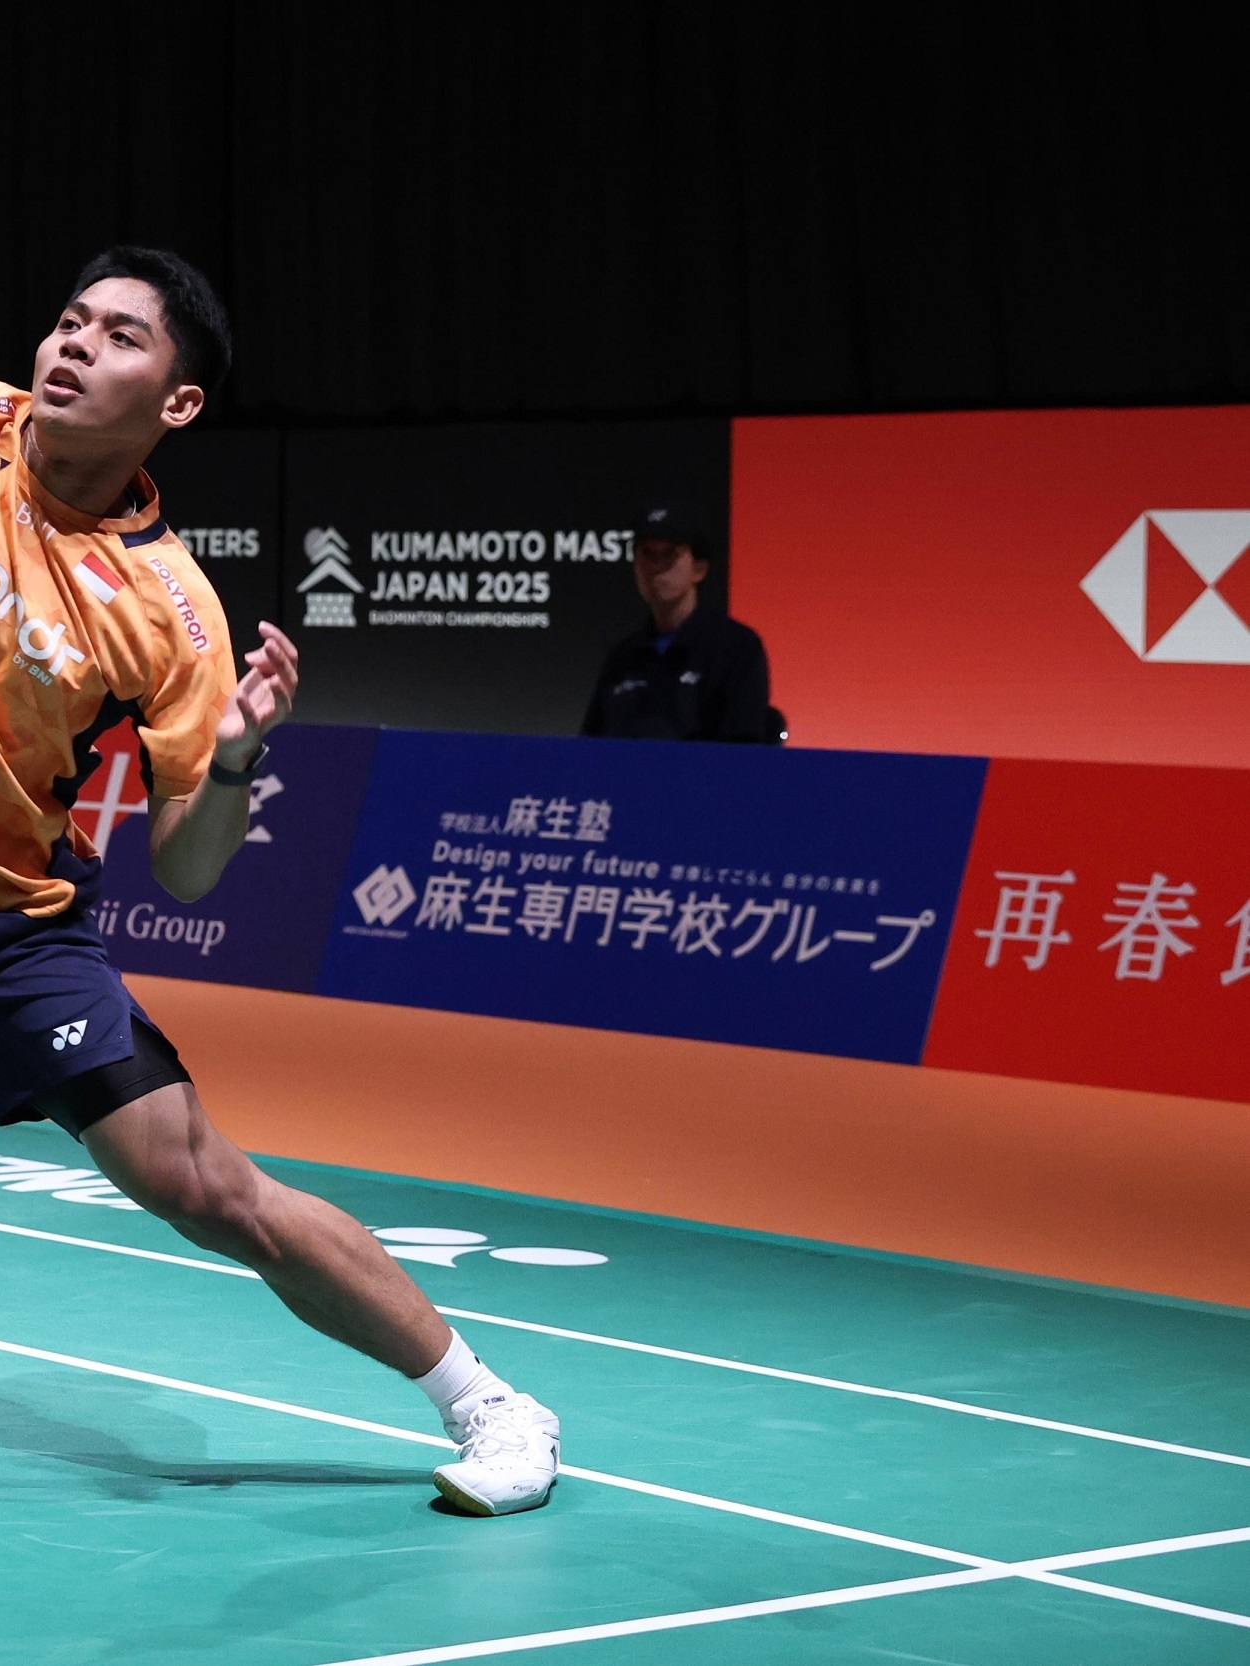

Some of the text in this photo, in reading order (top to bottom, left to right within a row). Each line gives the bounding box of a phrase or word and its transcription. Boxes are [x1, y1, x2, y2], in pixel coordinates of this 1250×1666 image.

[177, 528, 260, 557] STERS
[371, 530, 635, 562] KUMAMOTO MAST
[150, 558, 208, 651] POLYTRON
[369, 571, 550, 603] JAPAN 2025
[368, 610, 550, 628] BADMINTON CHAMPIONSHIPS
[12, 652, 54, 687] by BNI
[432, 839, 512, 873] Design
[516, 850, 574, 876] your
[582, 849, 661, 880] future
[125, 902, 227, 956] Group
[414, 871, 938, 971] 麻生専門学校グループ
